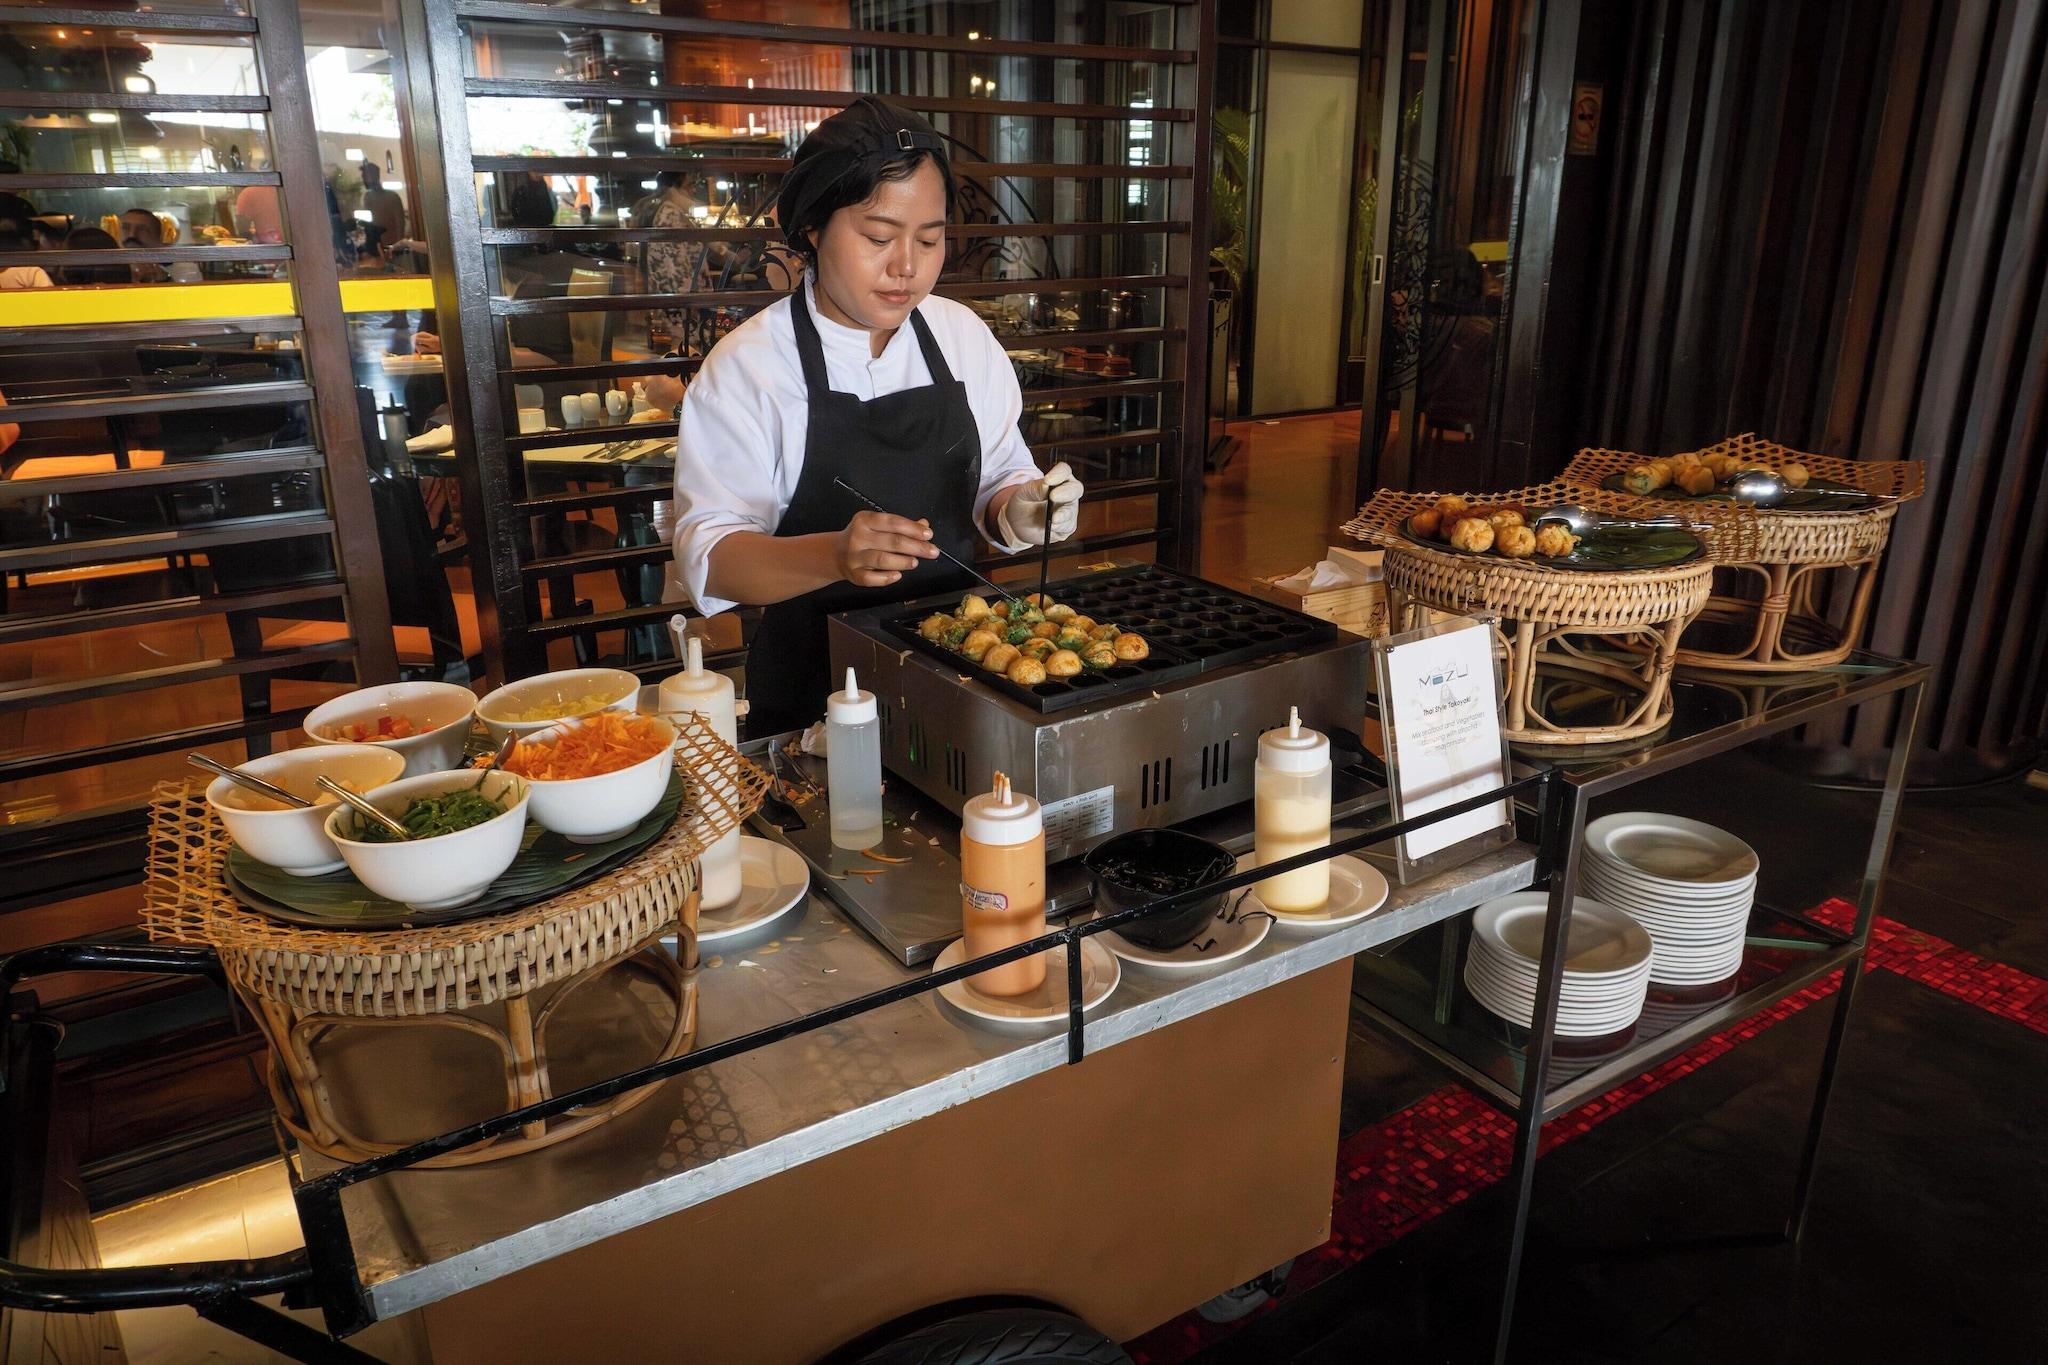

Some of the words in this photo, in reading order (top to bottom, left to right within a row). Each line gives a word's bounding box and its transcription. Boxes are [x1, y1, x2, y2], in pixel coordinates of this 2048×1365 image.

[1423, 708, 1434, 716] Thai
[1435, 704, 1447, 713] Style
[1448, 696, 1471, 708] Takoyaki
